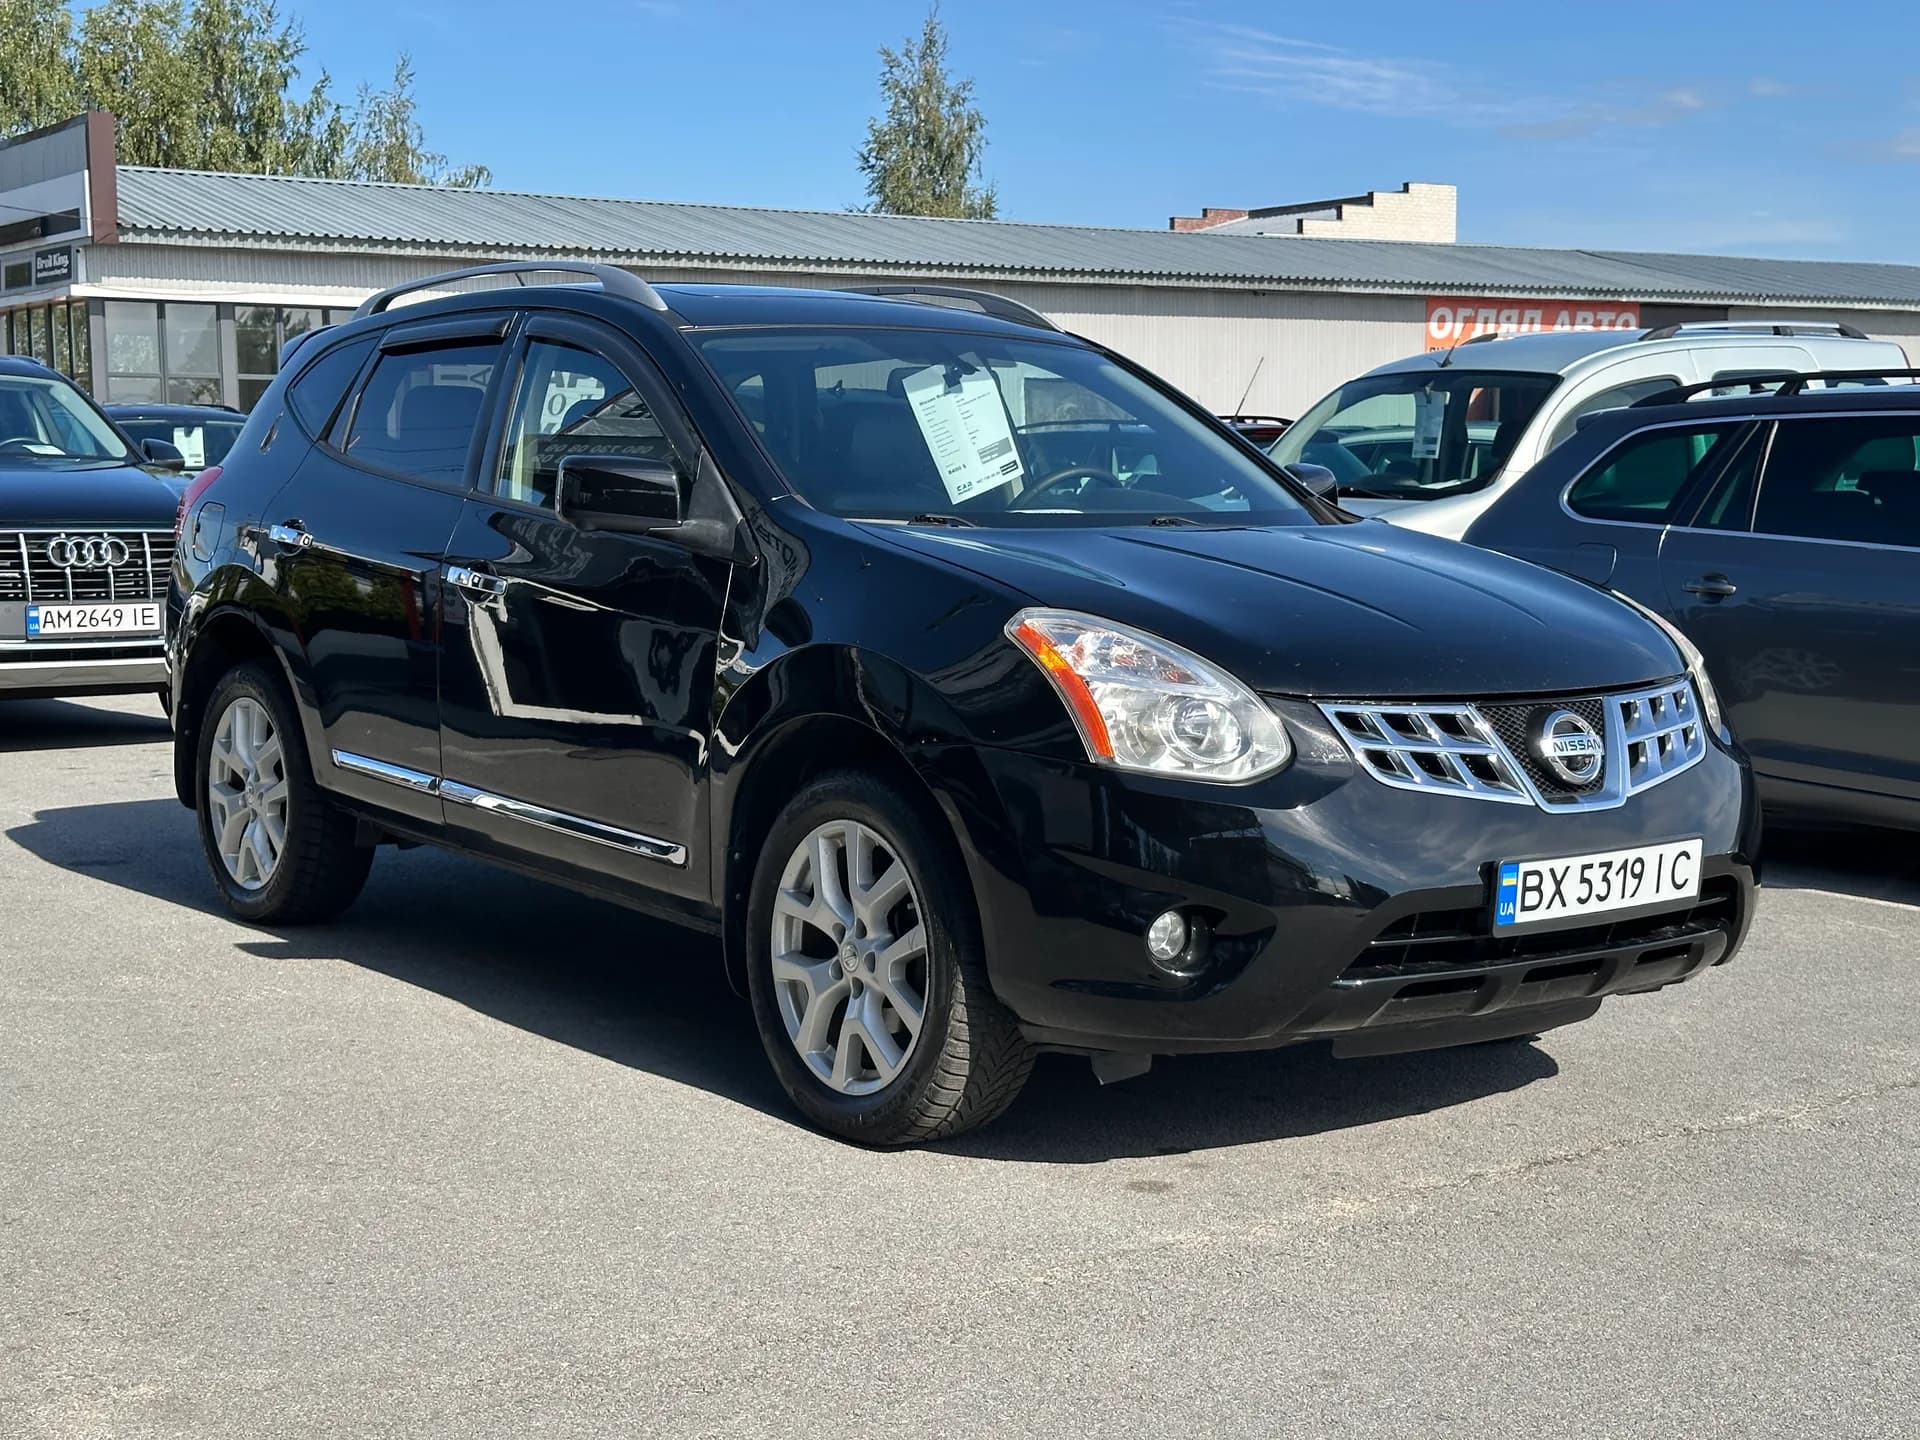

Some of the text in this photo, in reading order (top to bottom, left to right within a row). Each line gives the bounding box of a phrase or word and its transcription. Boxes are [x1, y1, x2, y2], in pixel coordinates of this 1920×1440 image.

[1428, 306, 1638, 340] ОГЛЯД АВТО
[42, 607, 155, 628] AM 2649 IE
[1552, 738, 1601, 753] NISSAN
[1519, 850, 1692, 913] BX 5319 IC
[1500, 902, 1515, 916] UA
